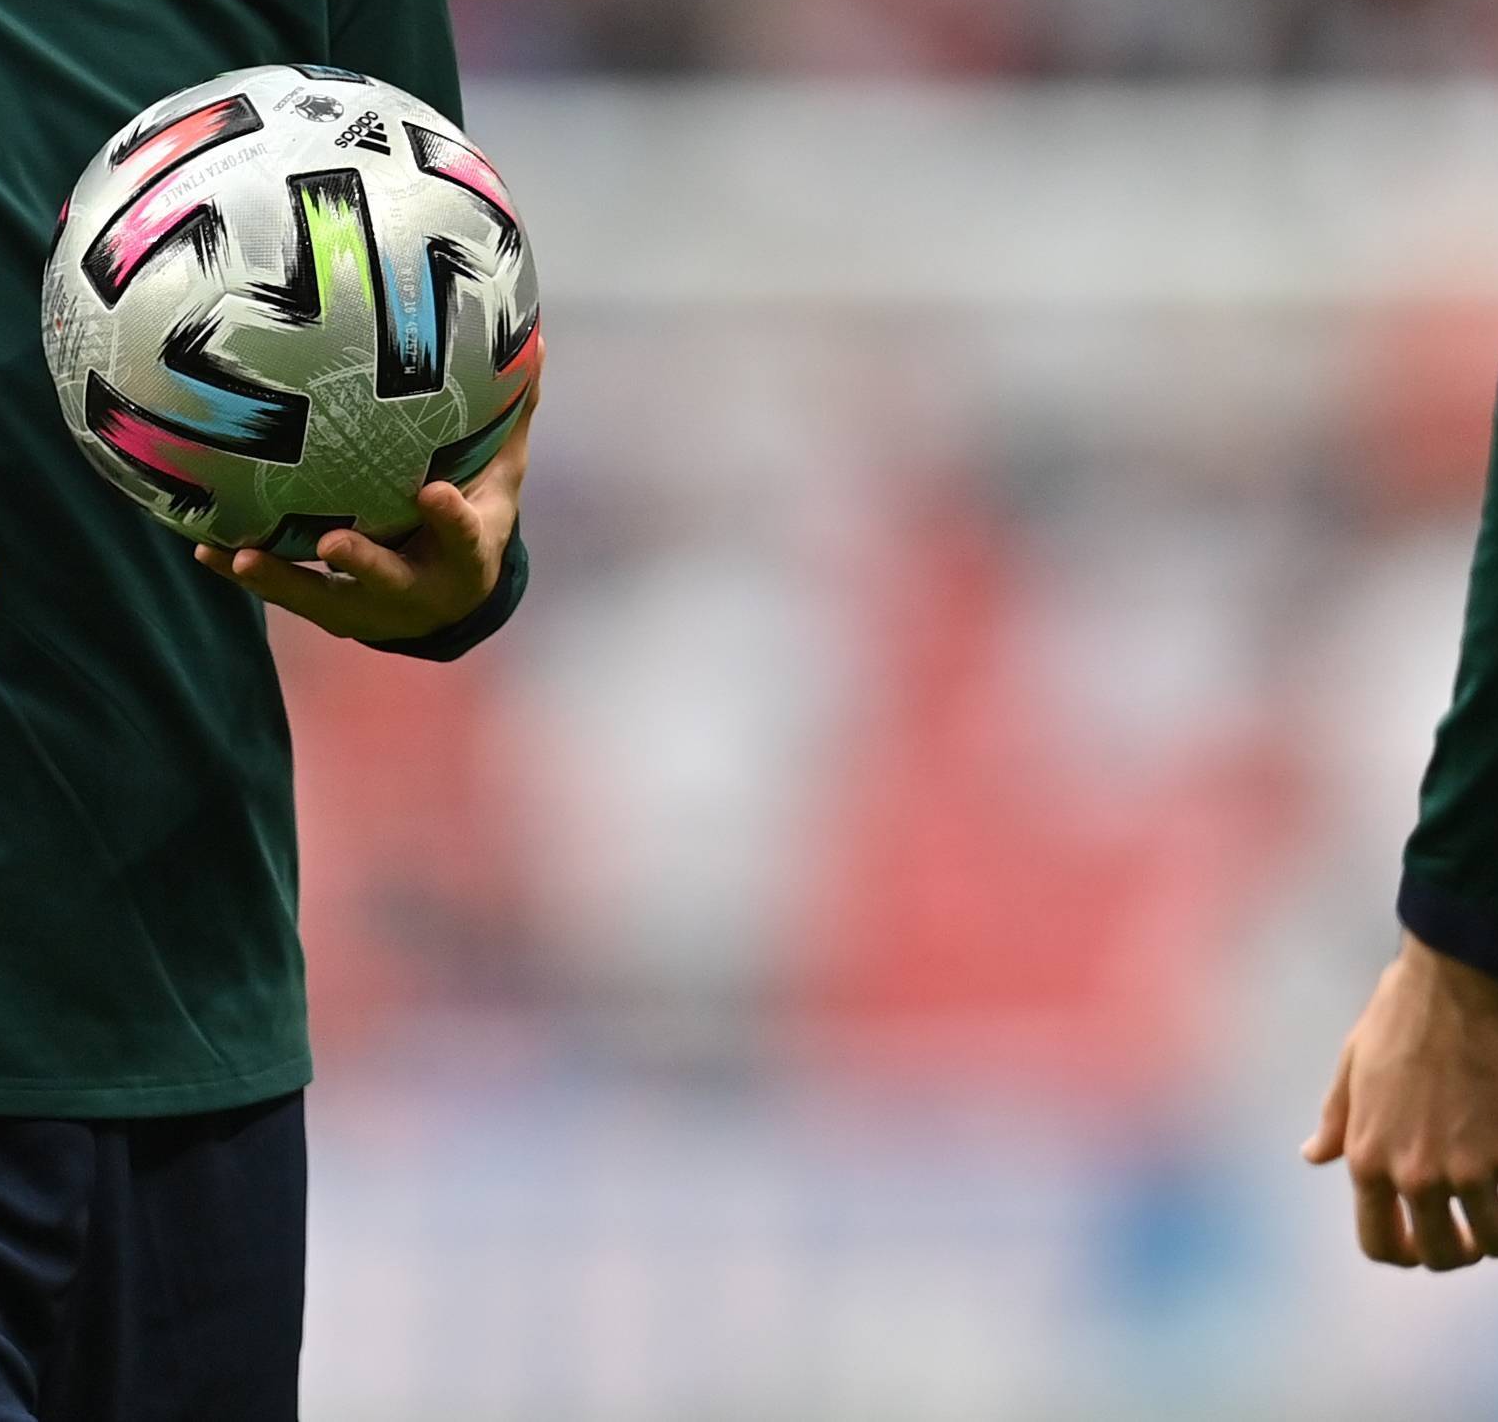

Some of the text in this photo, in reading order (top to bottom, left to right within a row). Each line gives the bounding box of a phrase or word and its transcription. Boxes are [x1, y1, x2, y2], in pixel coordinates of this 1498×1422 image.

[334, 110, 379, 149] adidas
[164, 141, 269, 208] UNIFORIA FINALE
